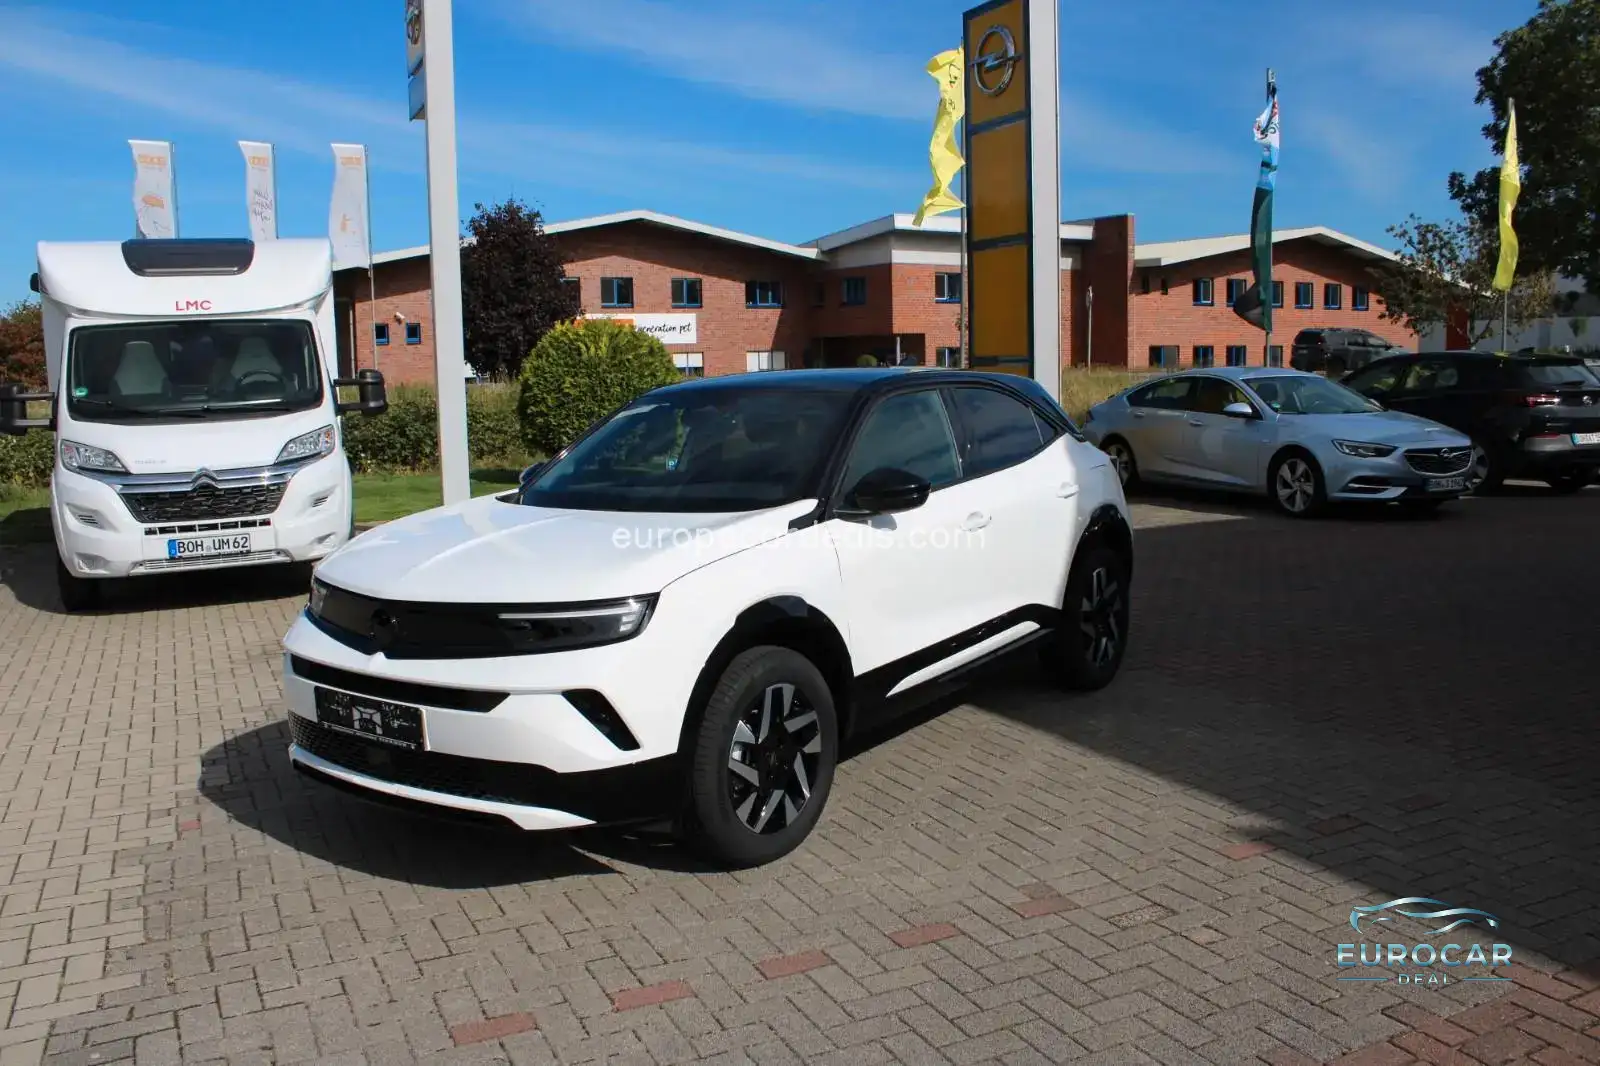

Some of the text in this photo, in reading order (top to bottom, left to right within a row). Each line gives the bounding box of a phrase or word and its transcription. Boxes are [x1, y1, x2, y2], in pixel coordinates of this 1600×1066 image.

[175, 299, 213, 311] LMC
[679, 321, 692, 335] pet
[177, 536, 249, 554] BOH UM 62
